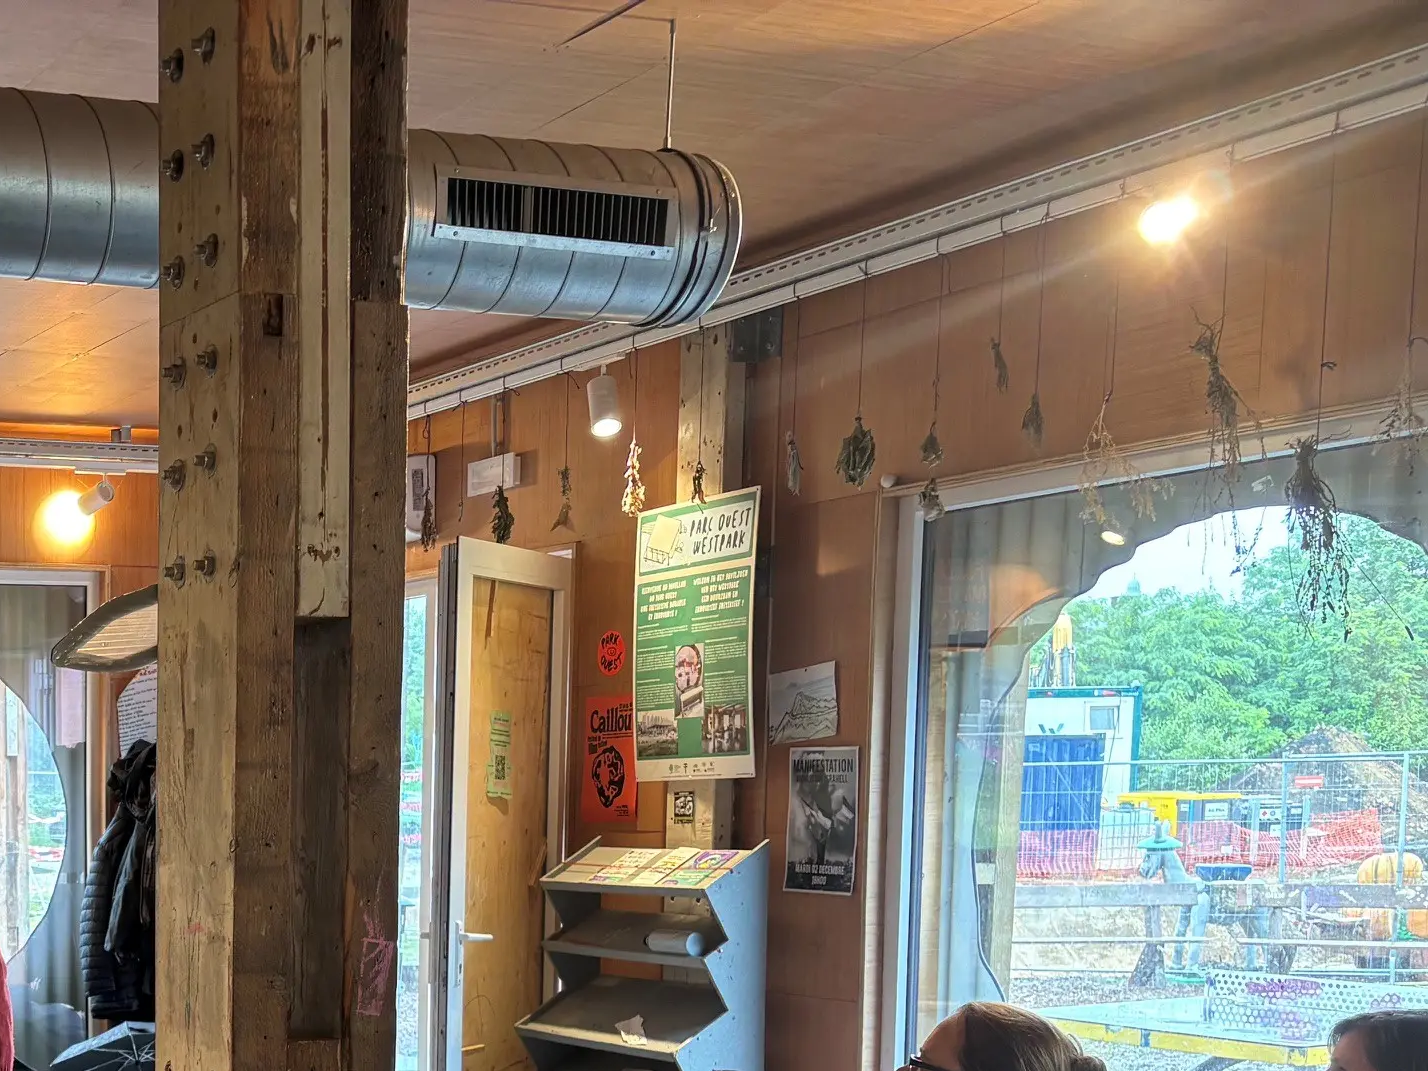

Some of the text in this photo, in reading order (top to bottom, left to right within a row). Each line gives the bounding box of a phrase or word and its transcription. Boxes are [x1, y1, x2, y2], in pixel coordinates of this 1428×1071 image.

[689, 507, 752, 537] PARC OUEST
[693, 530, 746, 555] WESTPARK
[601, 632, 620, 650] PARK
[600, 651, 623, 672] OUEST
[590, 706, 632, 734] Caillou
[793, 758, 854, 773] MANIFESTATION
